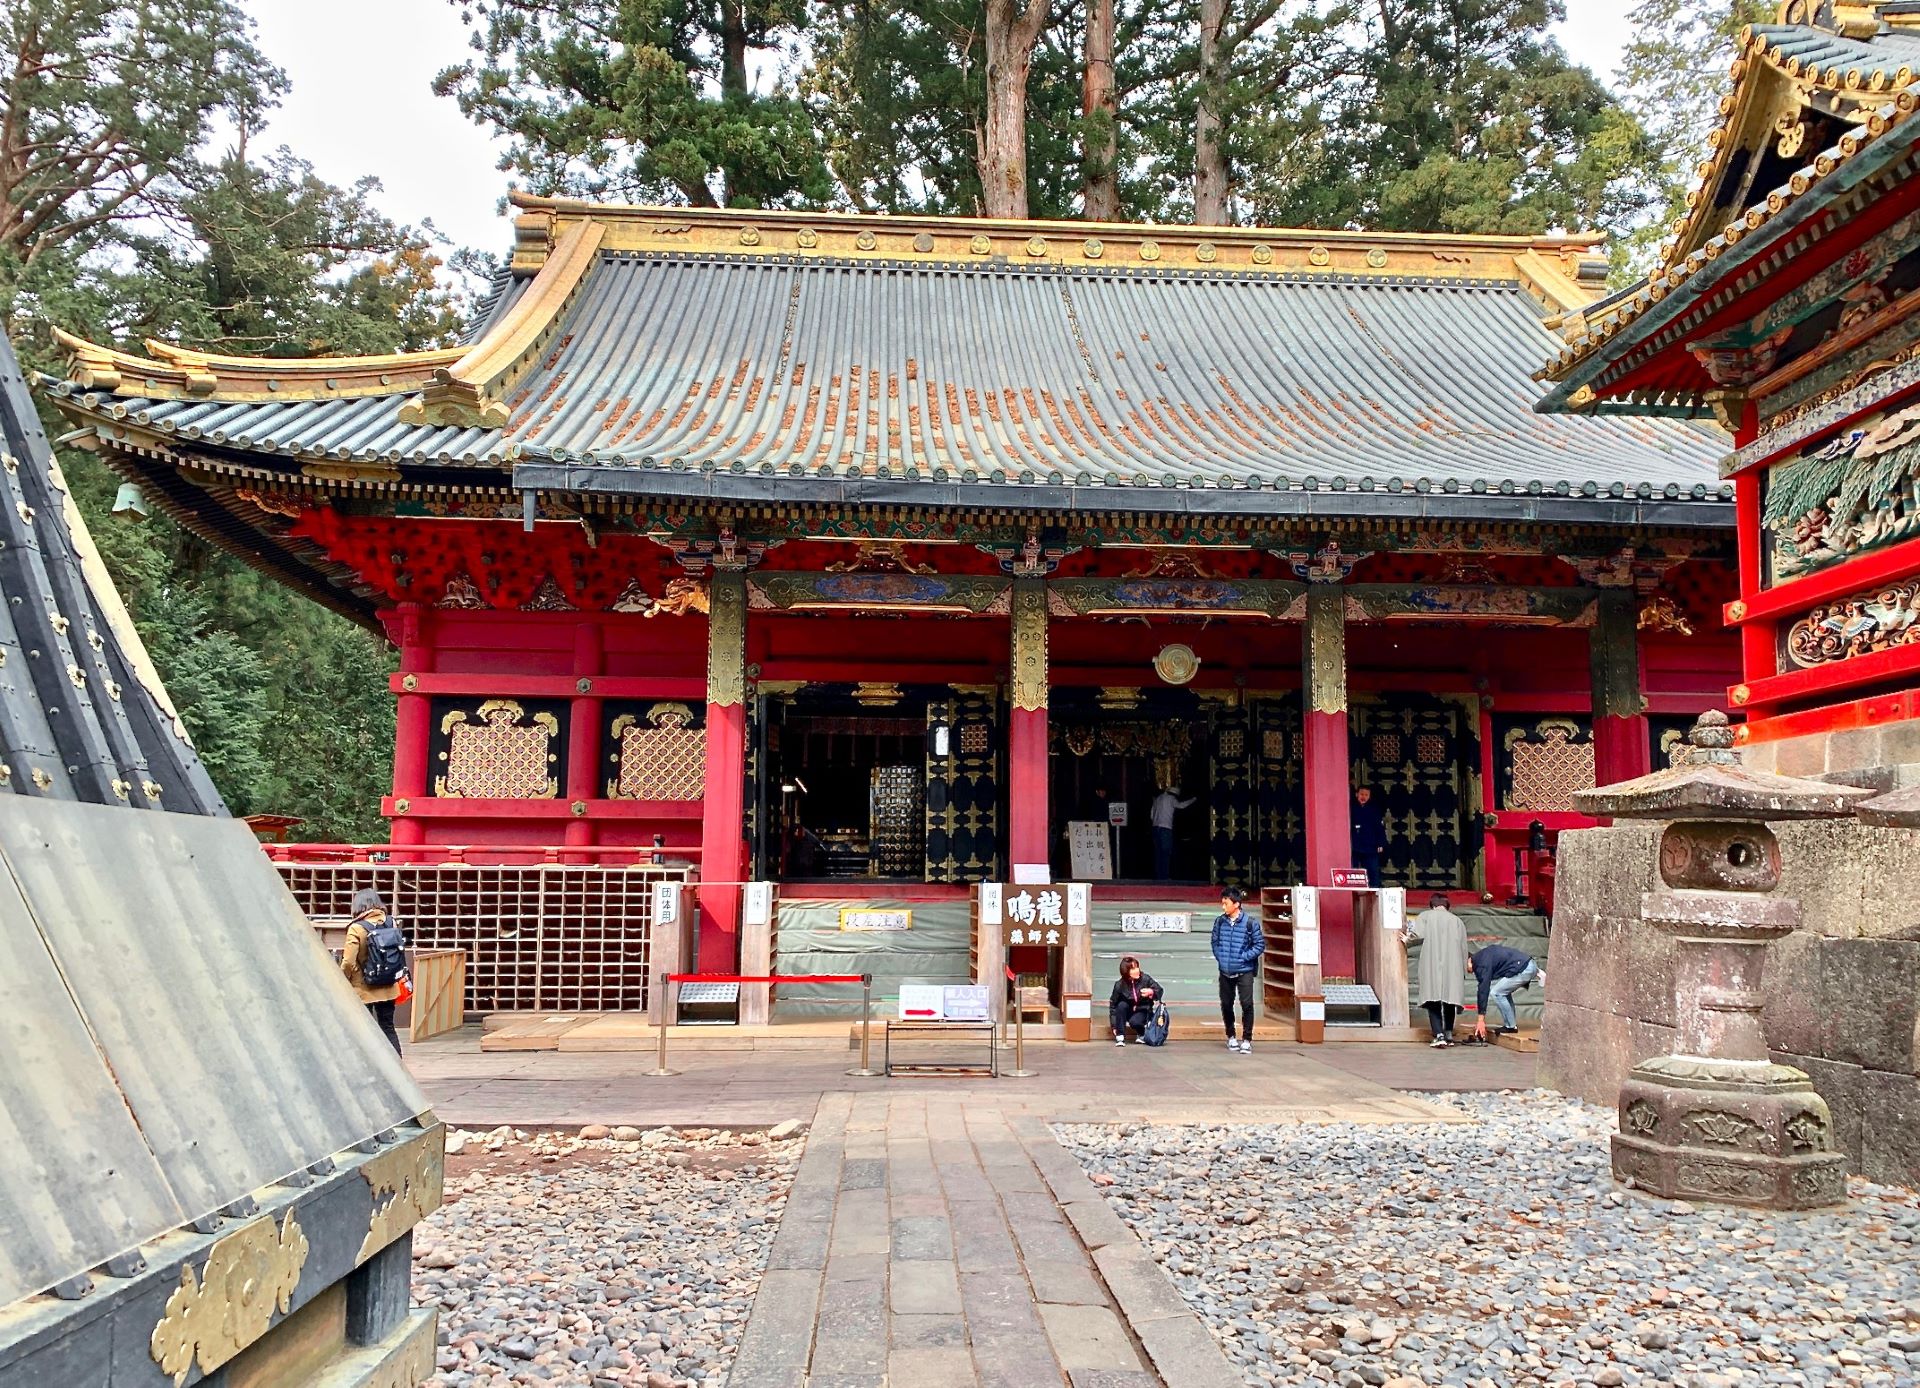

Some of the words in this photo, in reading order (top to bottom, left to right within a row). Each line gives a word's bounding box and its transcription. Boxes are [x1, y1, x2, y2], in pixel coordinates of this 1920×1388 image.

[661, 887, 671, 921] 団体用
[1006, 889, 1064, 926] 鳴龍
[1125, 915, 1184, 930] 段差注意
[1010, 929, 1060, 944] 薬師堂
